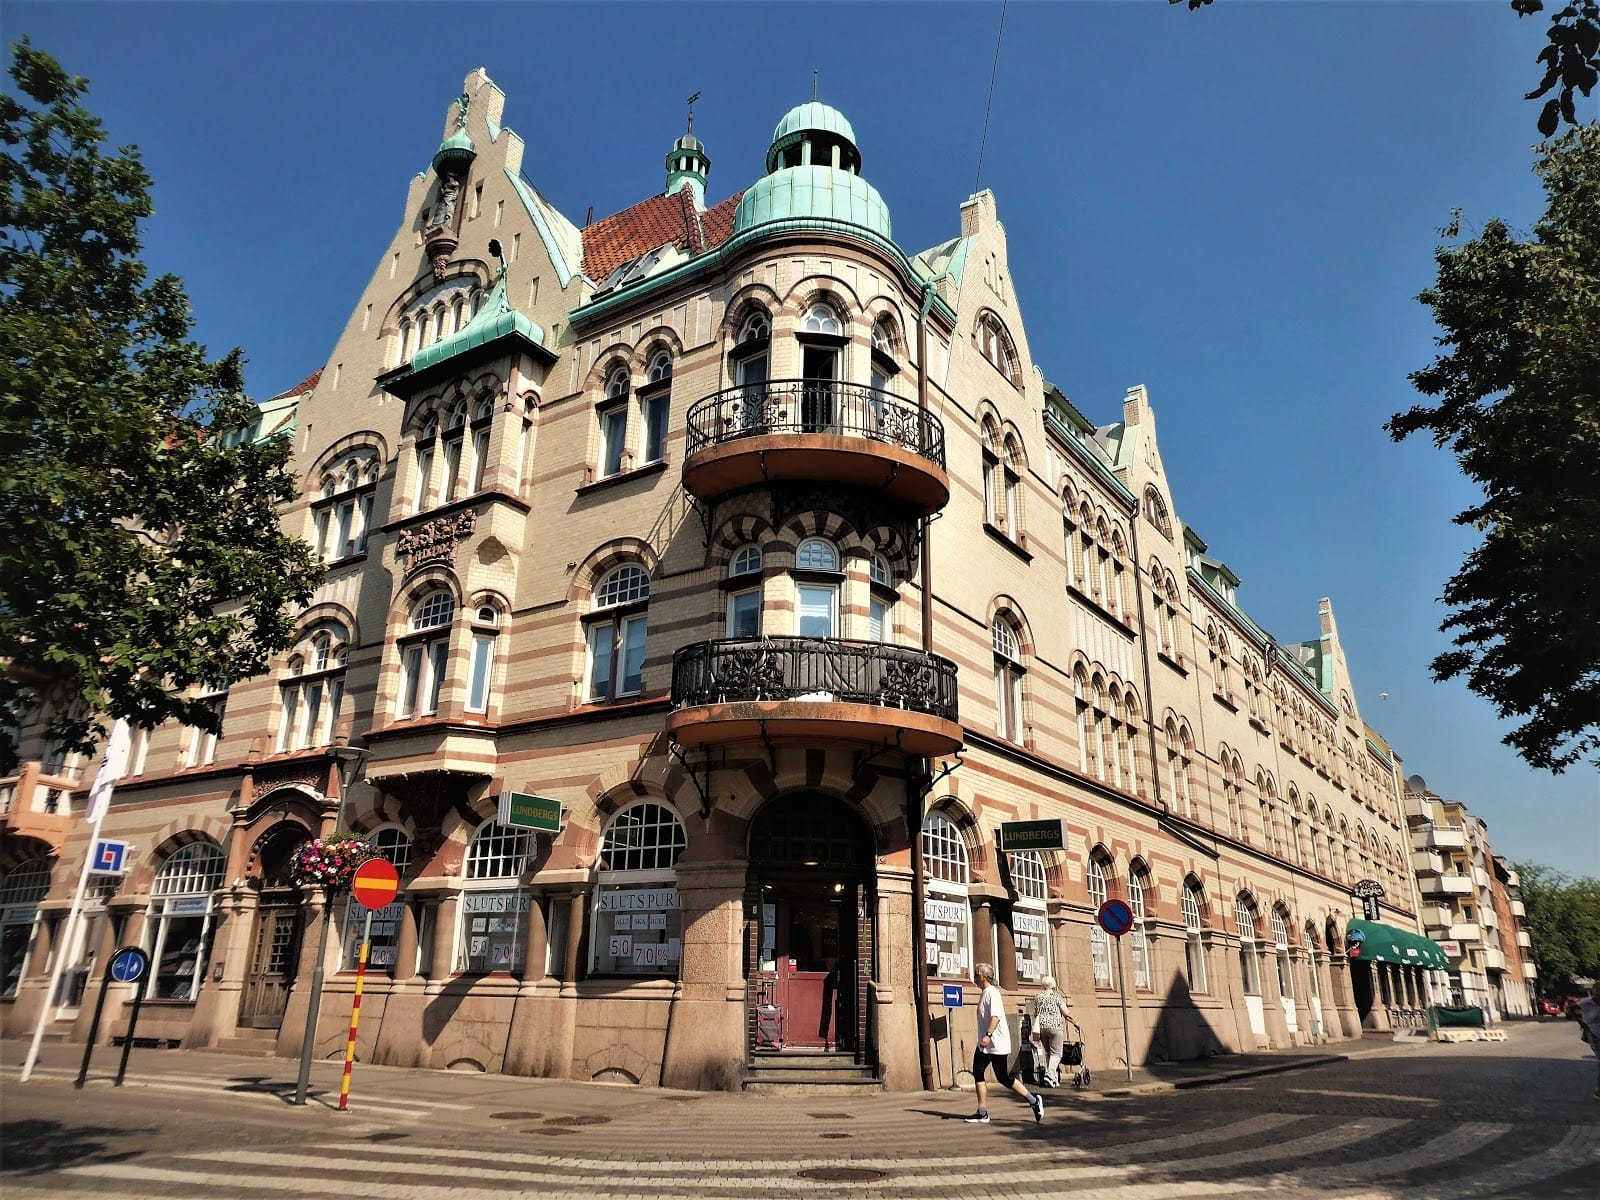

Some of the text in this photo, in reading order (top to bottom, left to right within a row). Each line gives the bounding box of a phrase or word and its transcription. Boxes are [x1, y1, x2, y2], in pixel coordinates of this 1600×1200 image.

[512, 804, 558, 820] LUNDBERGS
[1004, 829, 1060, 841] LUNDBERGS
[472, 940, 487, 953] 50
[494, 946, 520, 960] 70%
[611, 940, 629, 955] 50
[635, 948, 668, 963] 70%
